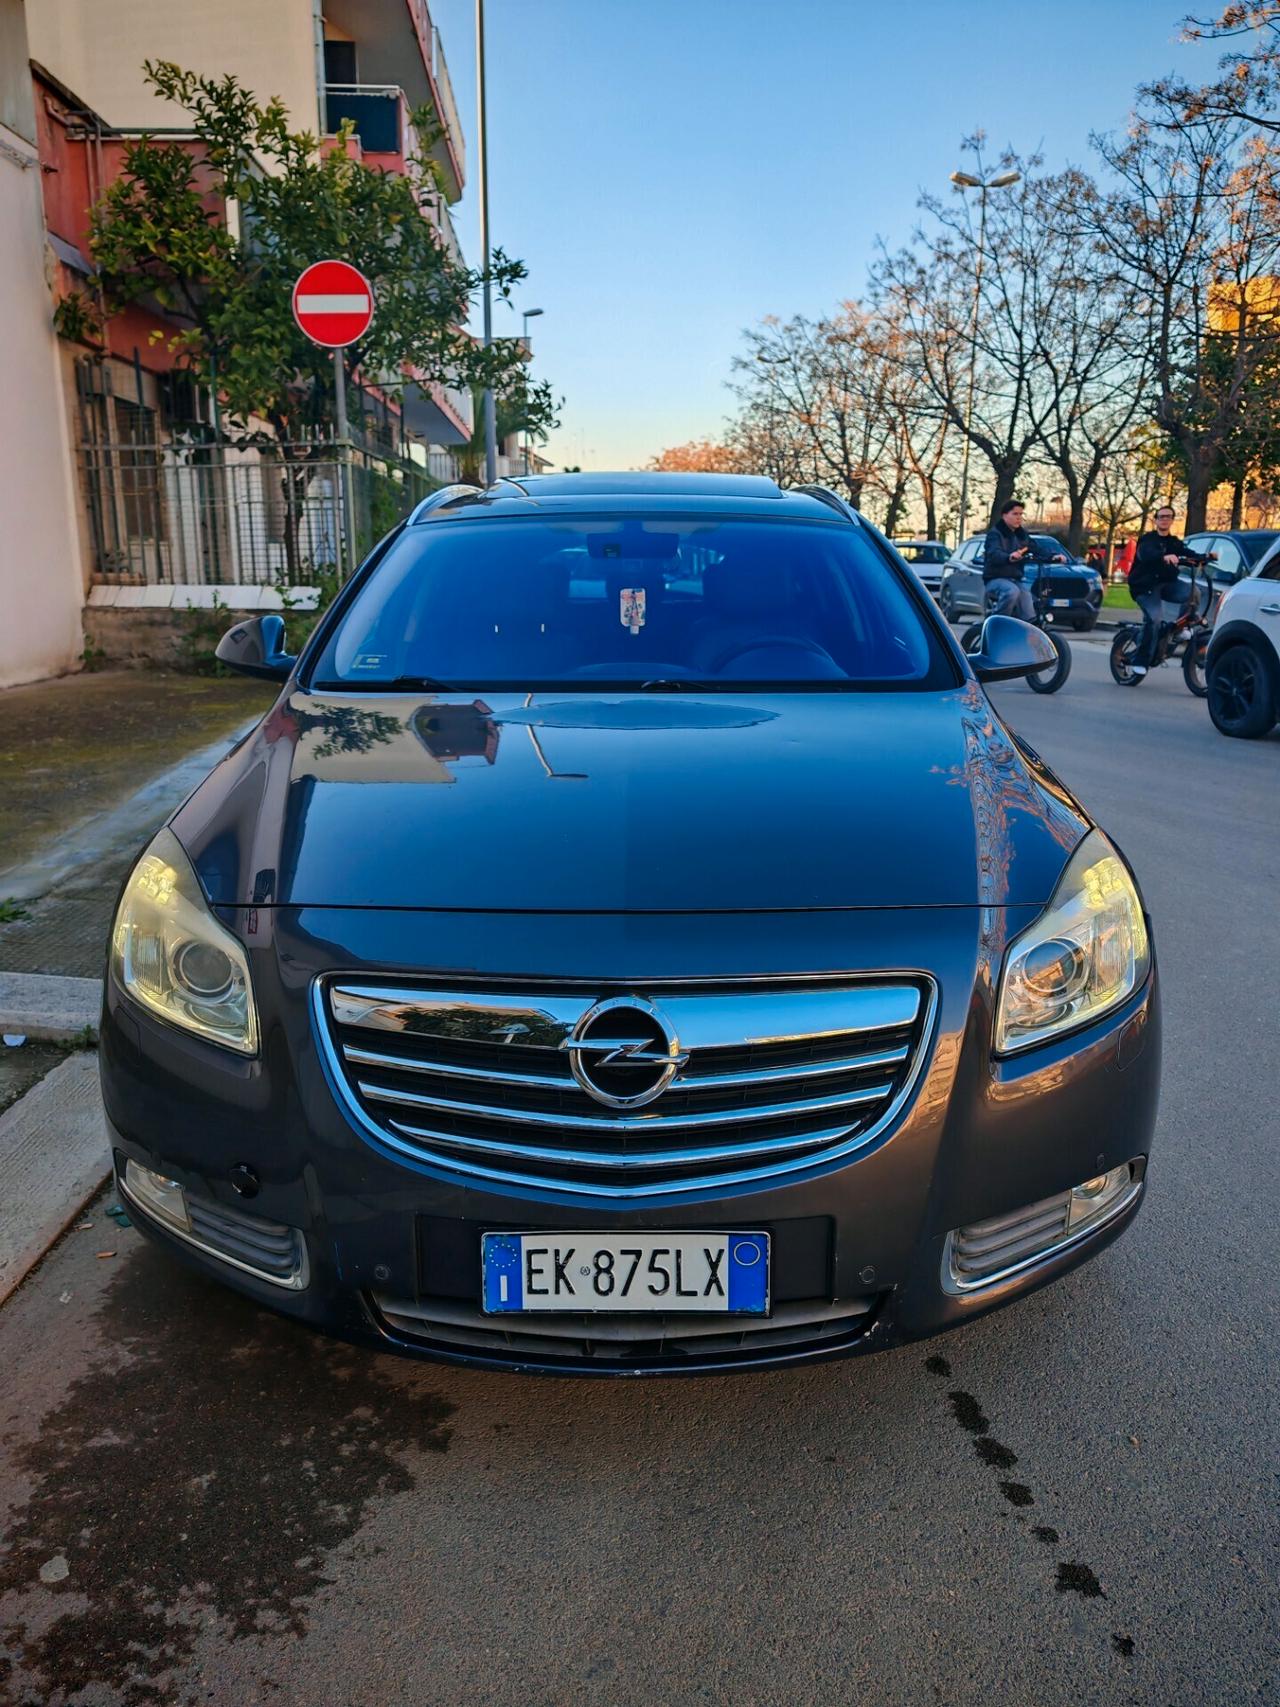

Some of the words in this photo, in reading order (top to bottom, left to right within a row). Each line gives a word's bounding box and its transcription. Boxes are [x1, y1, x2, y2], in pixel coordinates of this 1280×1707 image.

[500, 1275, 508, 1301] I
[526, 1248, 576, 1295] EK
[592, 1248, 725, 1297] 875LX
